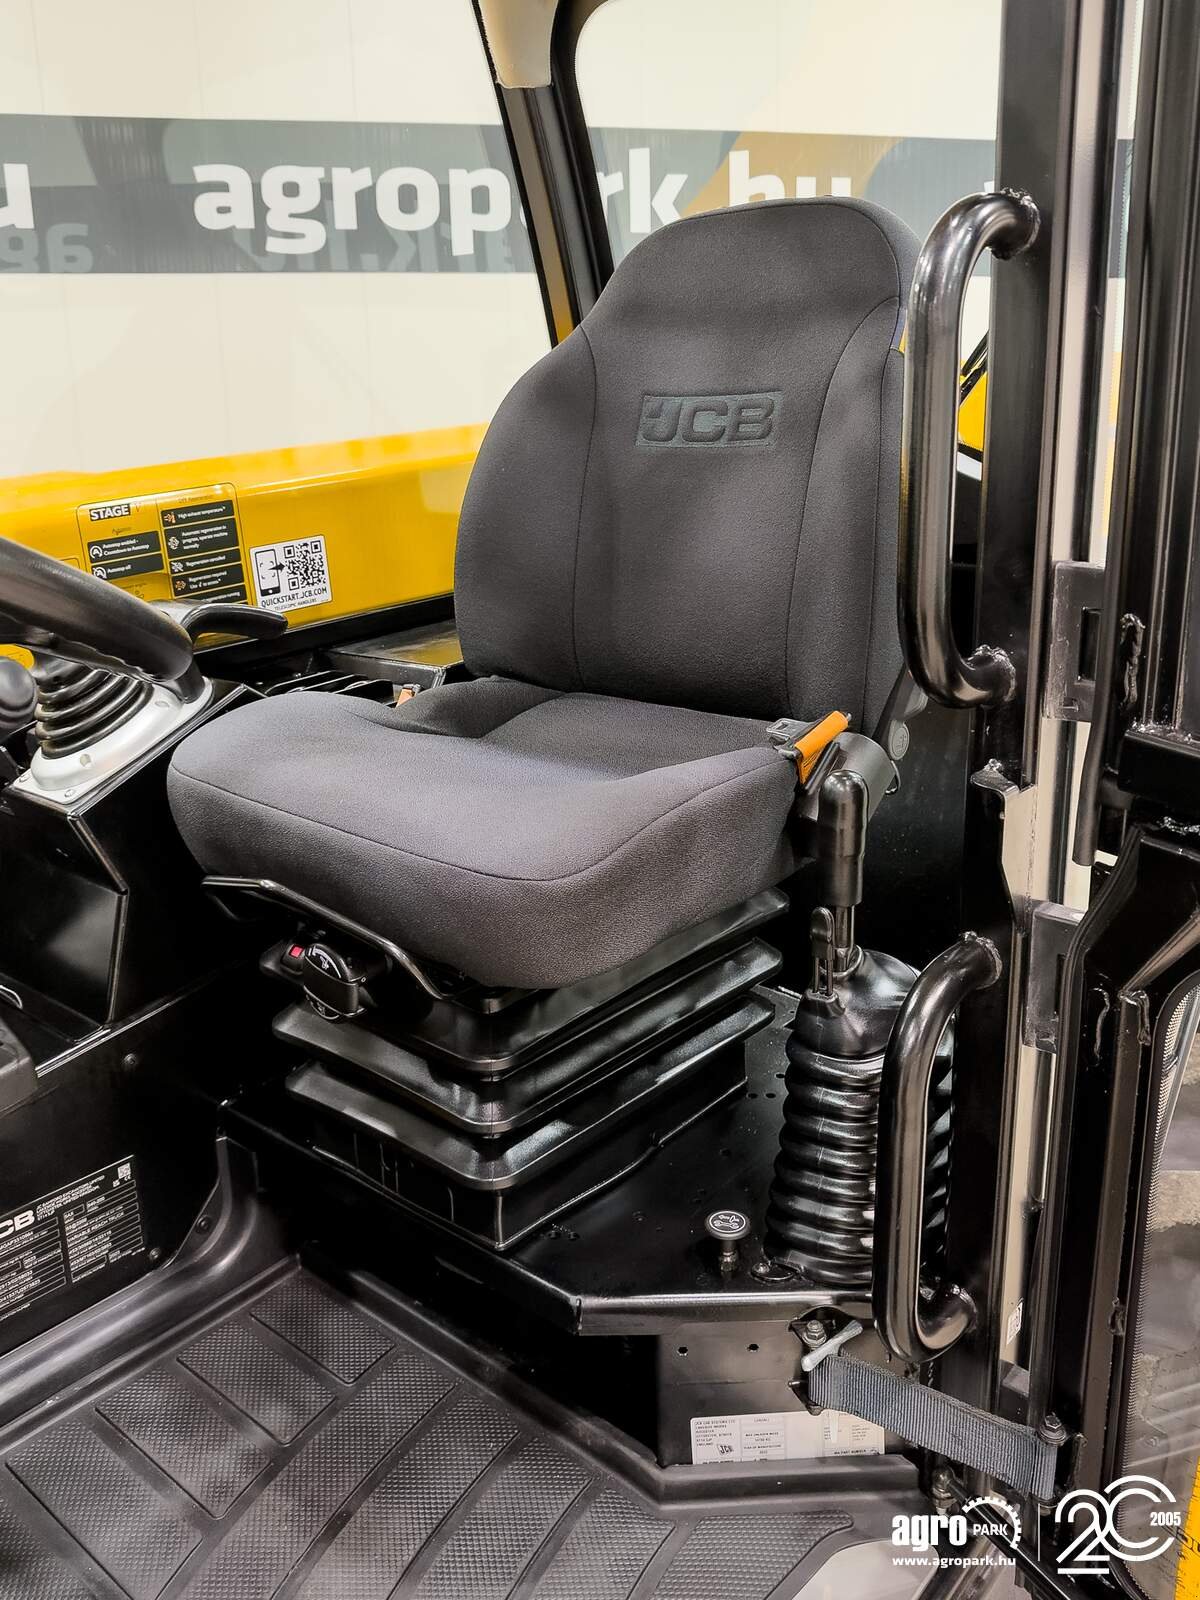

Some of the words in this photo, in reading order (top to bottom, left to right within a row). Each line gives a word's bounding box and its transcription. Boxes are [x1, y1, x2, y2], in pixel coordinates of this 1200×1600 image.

[641, 399, 775, 442] JCB
[90, 505, 130, 520] STAGE
[261, 587, 328, 608] QUICKSTART.JCB.COM
[0, 1210, 35, 1239] CB
